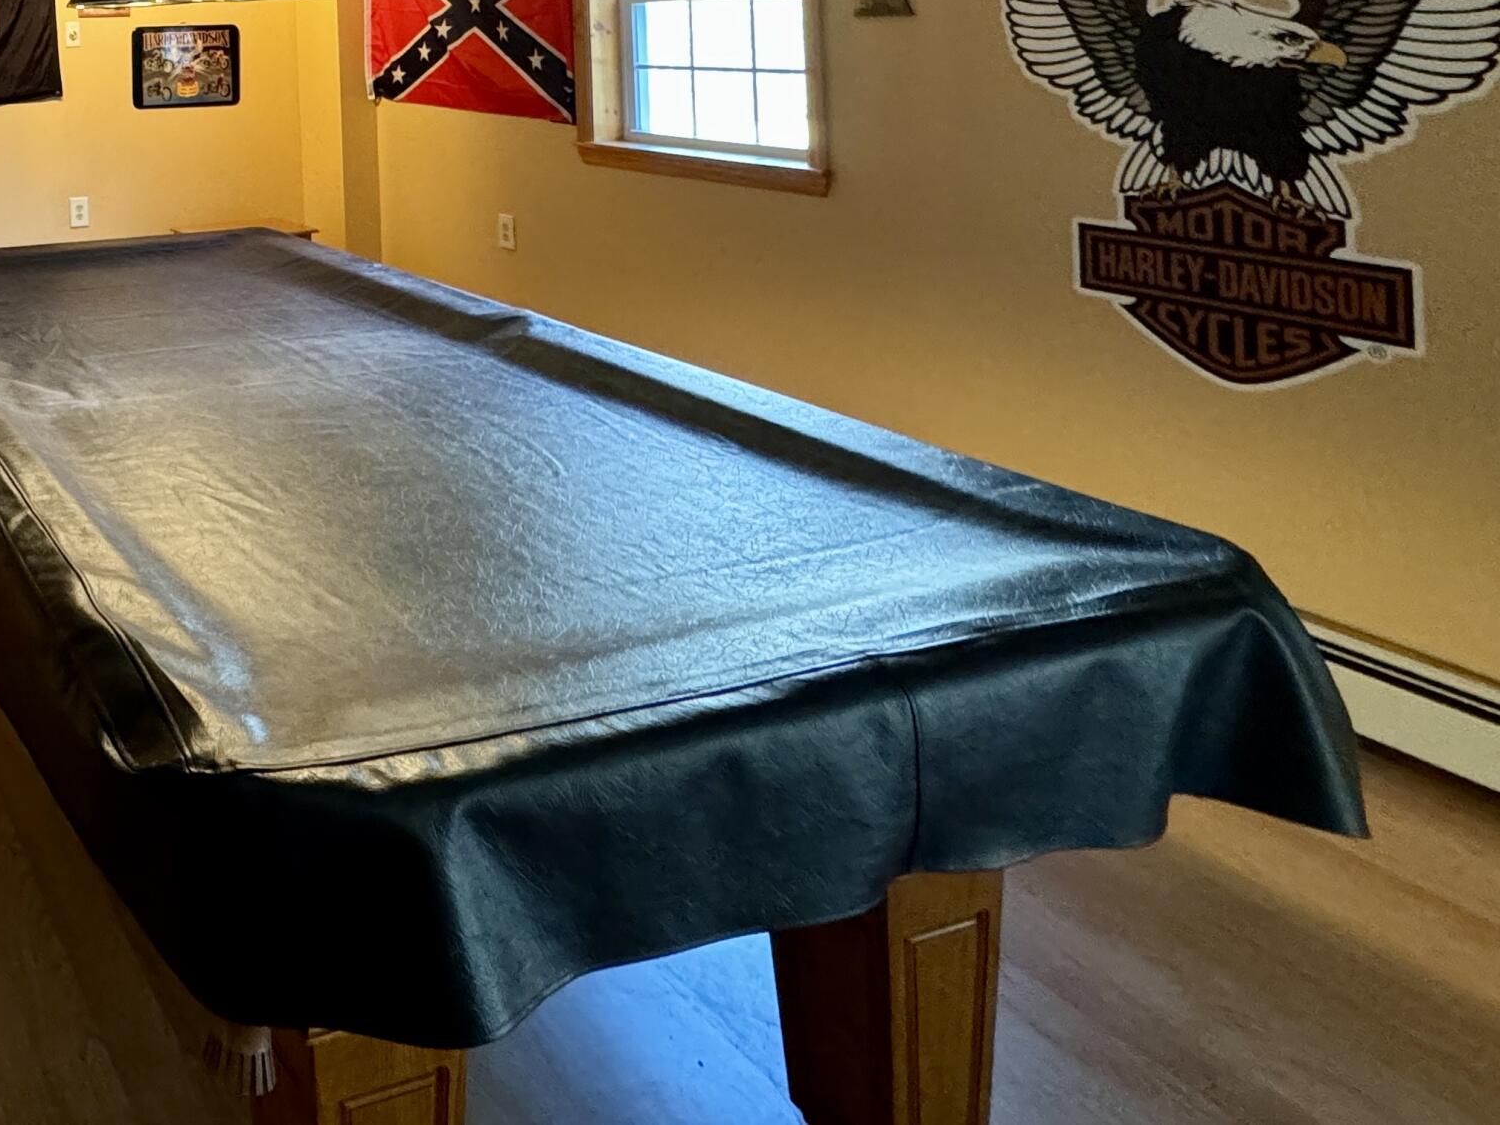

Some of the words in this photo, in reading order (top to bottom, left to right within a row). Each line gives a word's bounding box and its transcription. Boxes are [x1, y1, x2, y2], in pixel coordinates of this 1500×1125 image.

[1156, 202, 1307, 256] MOTOR
[1099, 242, 1389, 324] HARLEY-DAVIDSON
[1156, 303, 1311, 369] CYCLES
